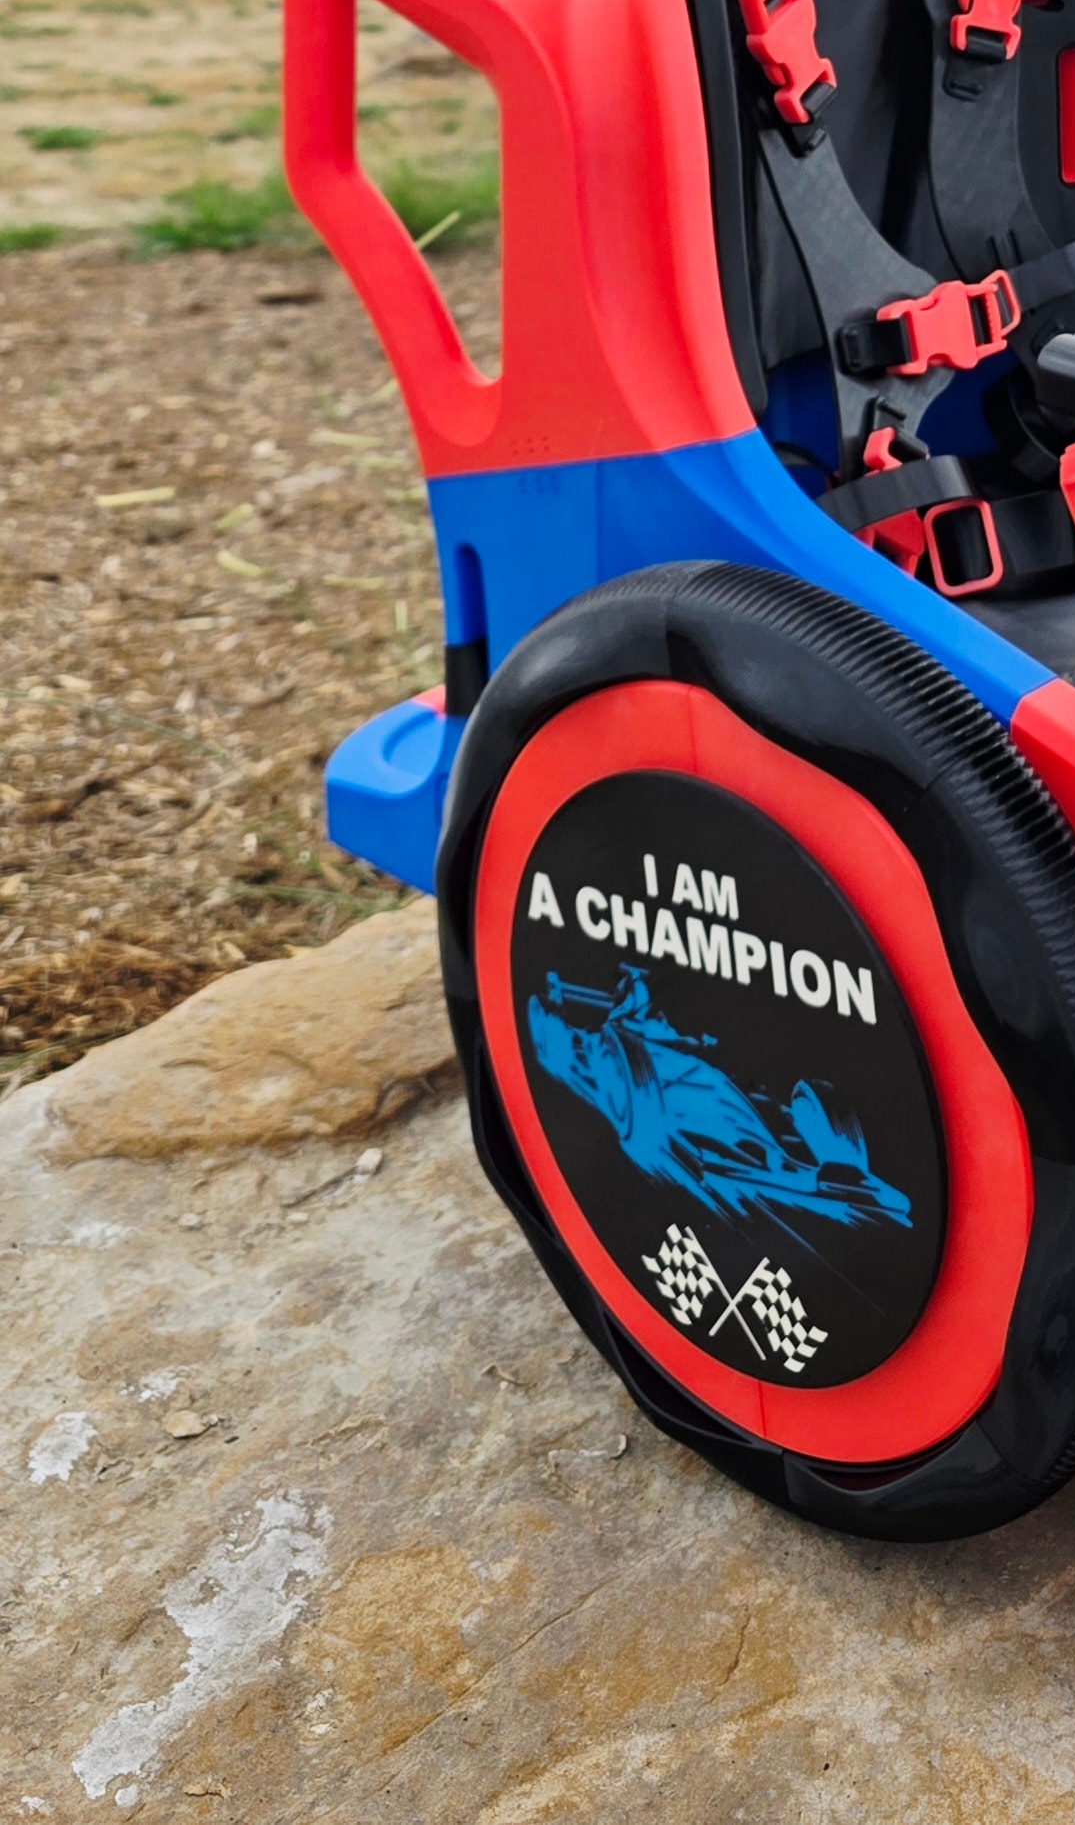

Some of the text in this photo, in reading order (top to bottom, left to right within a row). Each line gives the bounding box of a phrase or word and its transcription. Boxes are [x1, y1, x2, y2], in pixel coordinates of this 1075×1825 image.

[643, 853, 740, 921] I AM
[527, 871, 878, 1025] A CHAMPION
